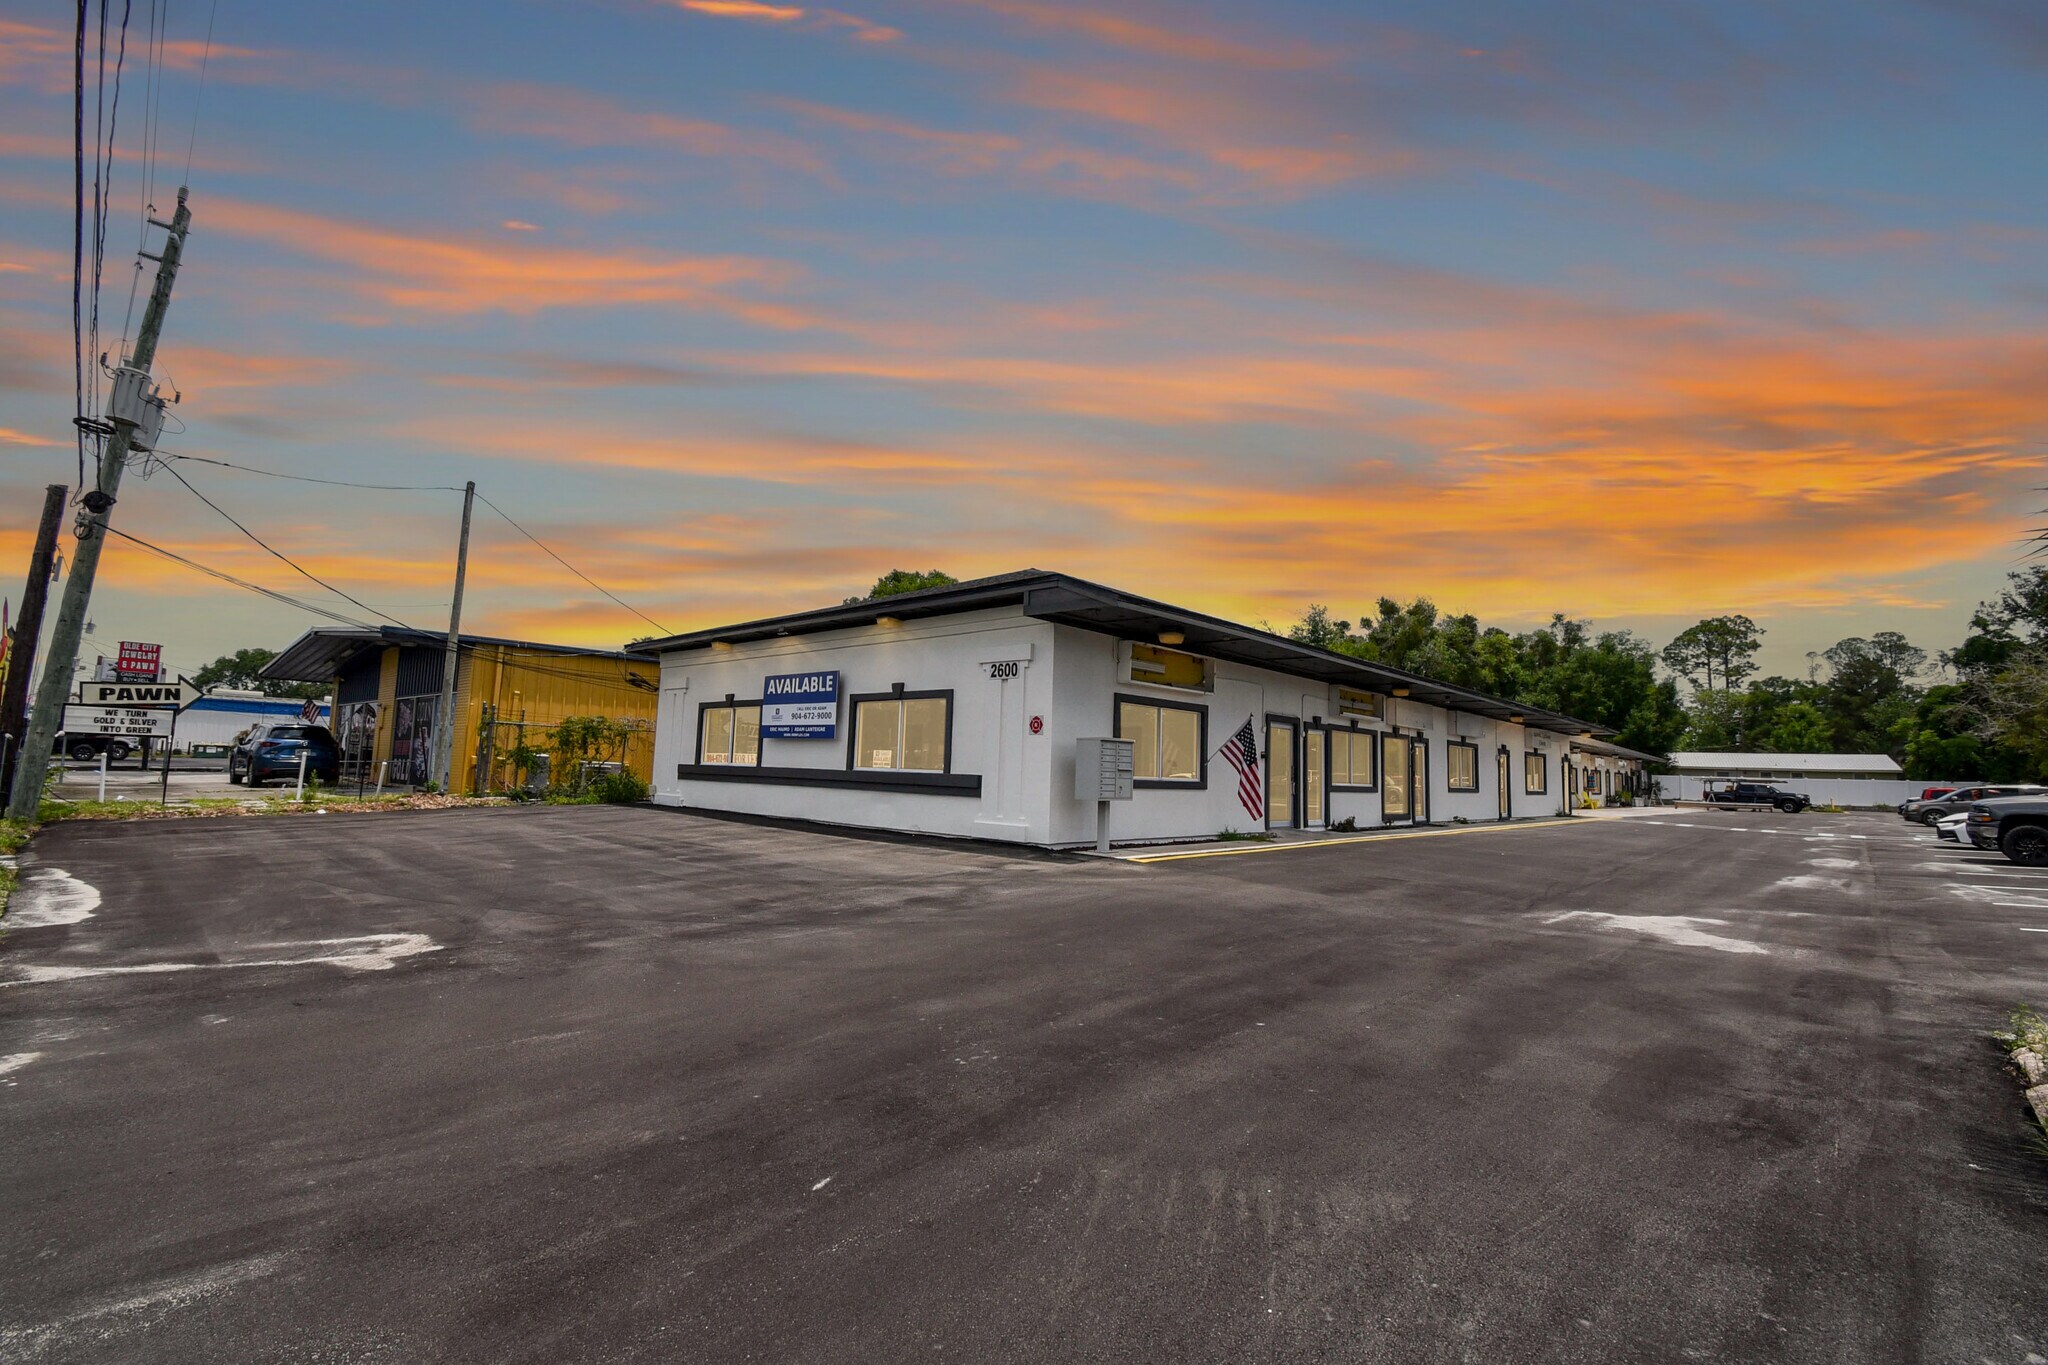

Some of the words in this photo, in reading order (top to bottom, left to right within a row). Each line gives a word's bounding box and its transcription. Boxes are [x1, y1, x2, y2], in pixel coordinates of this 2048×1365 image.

[123, 642, 140, 650] OLDE
[121, 650, 158, 660] JEWELRY
[122, 660, 127, 668] &
[130, 661, 155, 670] PAWN
[990, 662, 1018, 678] 2600
[767, 675, 834, 695] AVAILABLE
[99, 687, 180, 700] PAWN
[125, 710, 148, 718] TURN
[791, 712, 832, 720] 904-672-9000
[93, 717, 116, 725] GOLD
[129, 718, 157, 726] SILVER
[100, 725, 121, 733] INTO
[126, 726, 152, 734] GREEN
